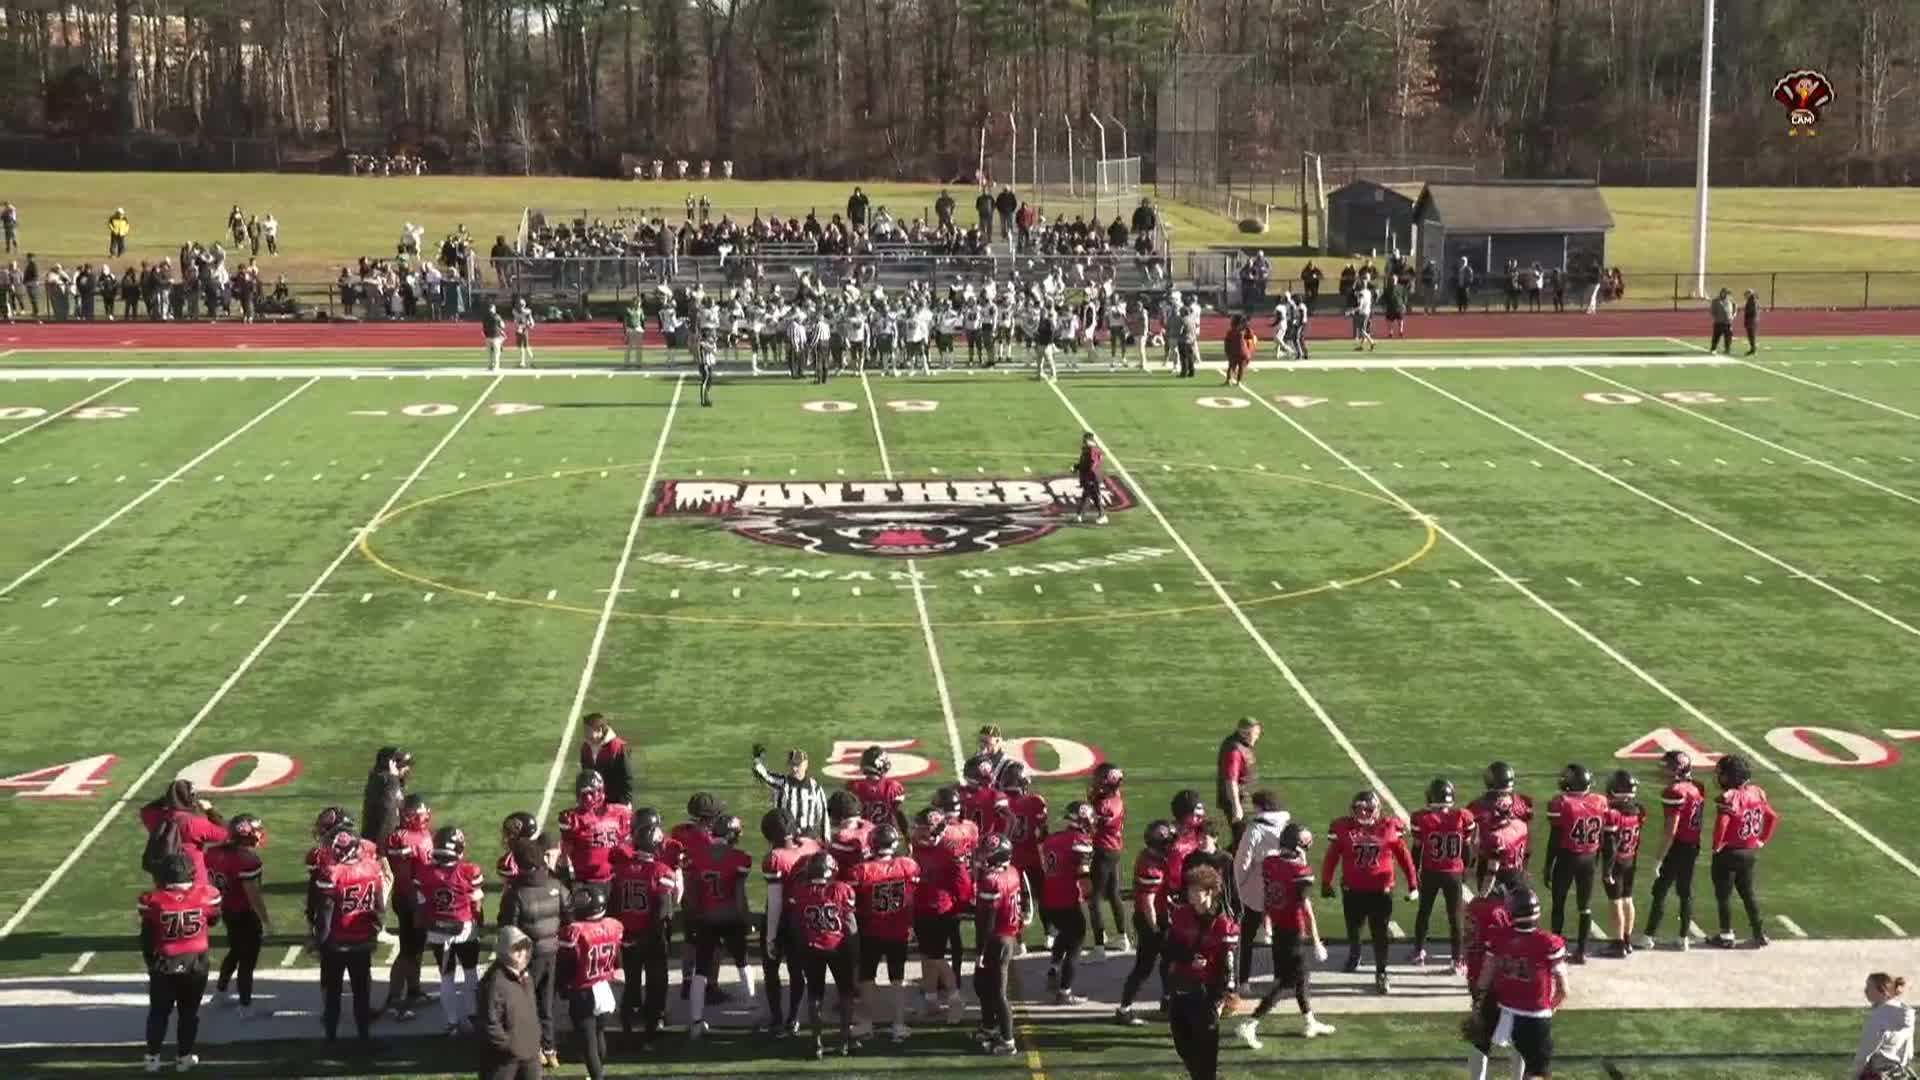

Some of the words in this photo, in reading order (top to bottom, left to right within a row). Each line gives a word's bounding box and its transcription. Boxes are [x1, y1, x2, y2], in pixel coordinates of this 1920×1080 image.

[0, 750, 304, 800] 40
[821, 736, 1104, 782] 50
[1569, 815, 1602, 849] 42
[342, 882, 376, 914] 54
[622, 879, 649, 912] 15
[160, 908, 202, 940] 75
[587, 943, 616, 979] 17
